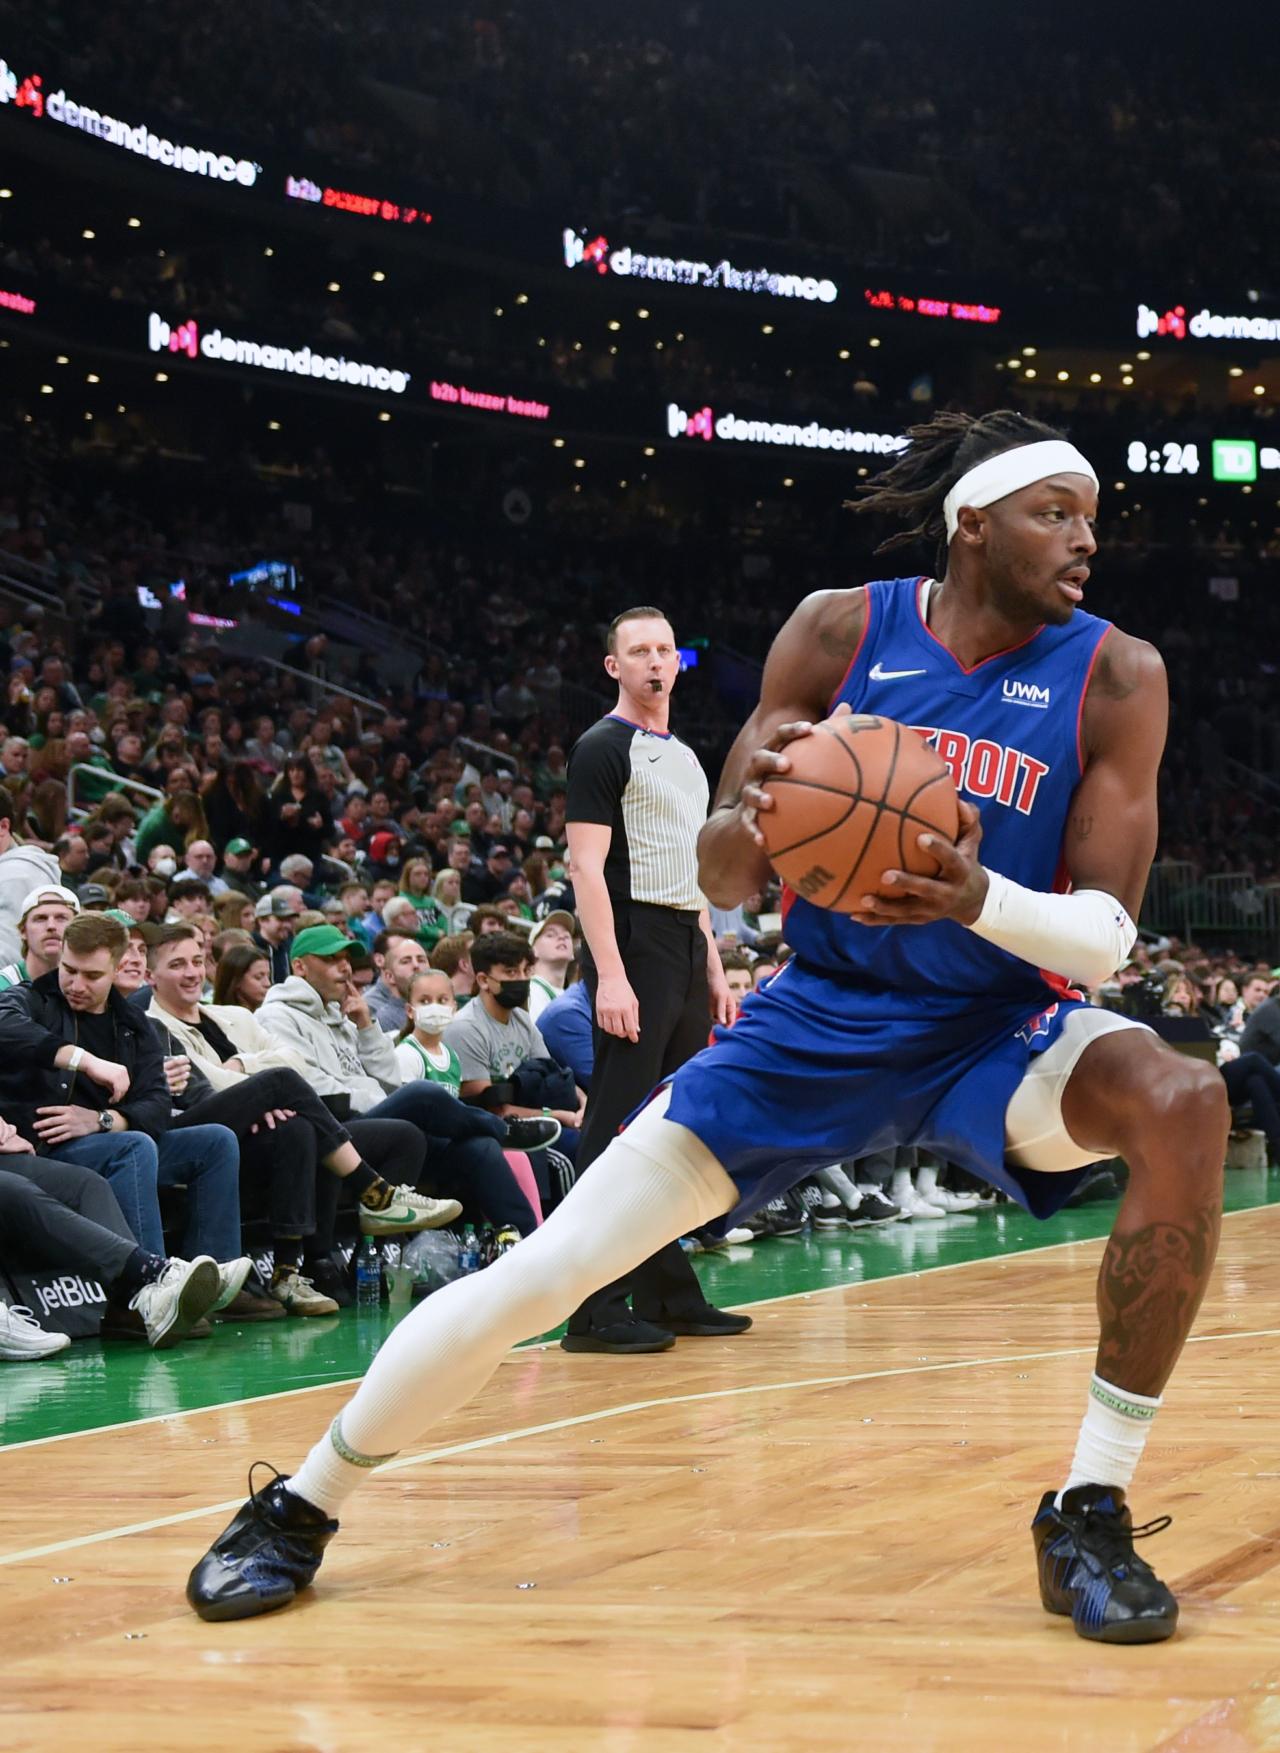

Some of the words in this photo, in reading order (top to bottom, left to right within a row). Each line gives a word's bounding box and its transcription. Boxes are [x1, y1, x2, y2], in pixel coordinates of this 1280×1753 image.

[46, 88, 256, 187] demandscience
[201, 329, 407, 394] demandscience
[1127, 440, 1200, 475] 8:24
[1217, 447, 1252, 474] TD
[1003, 679, 1050, 703] UWM
[31, 1275, 108, 1316] jetBlu
